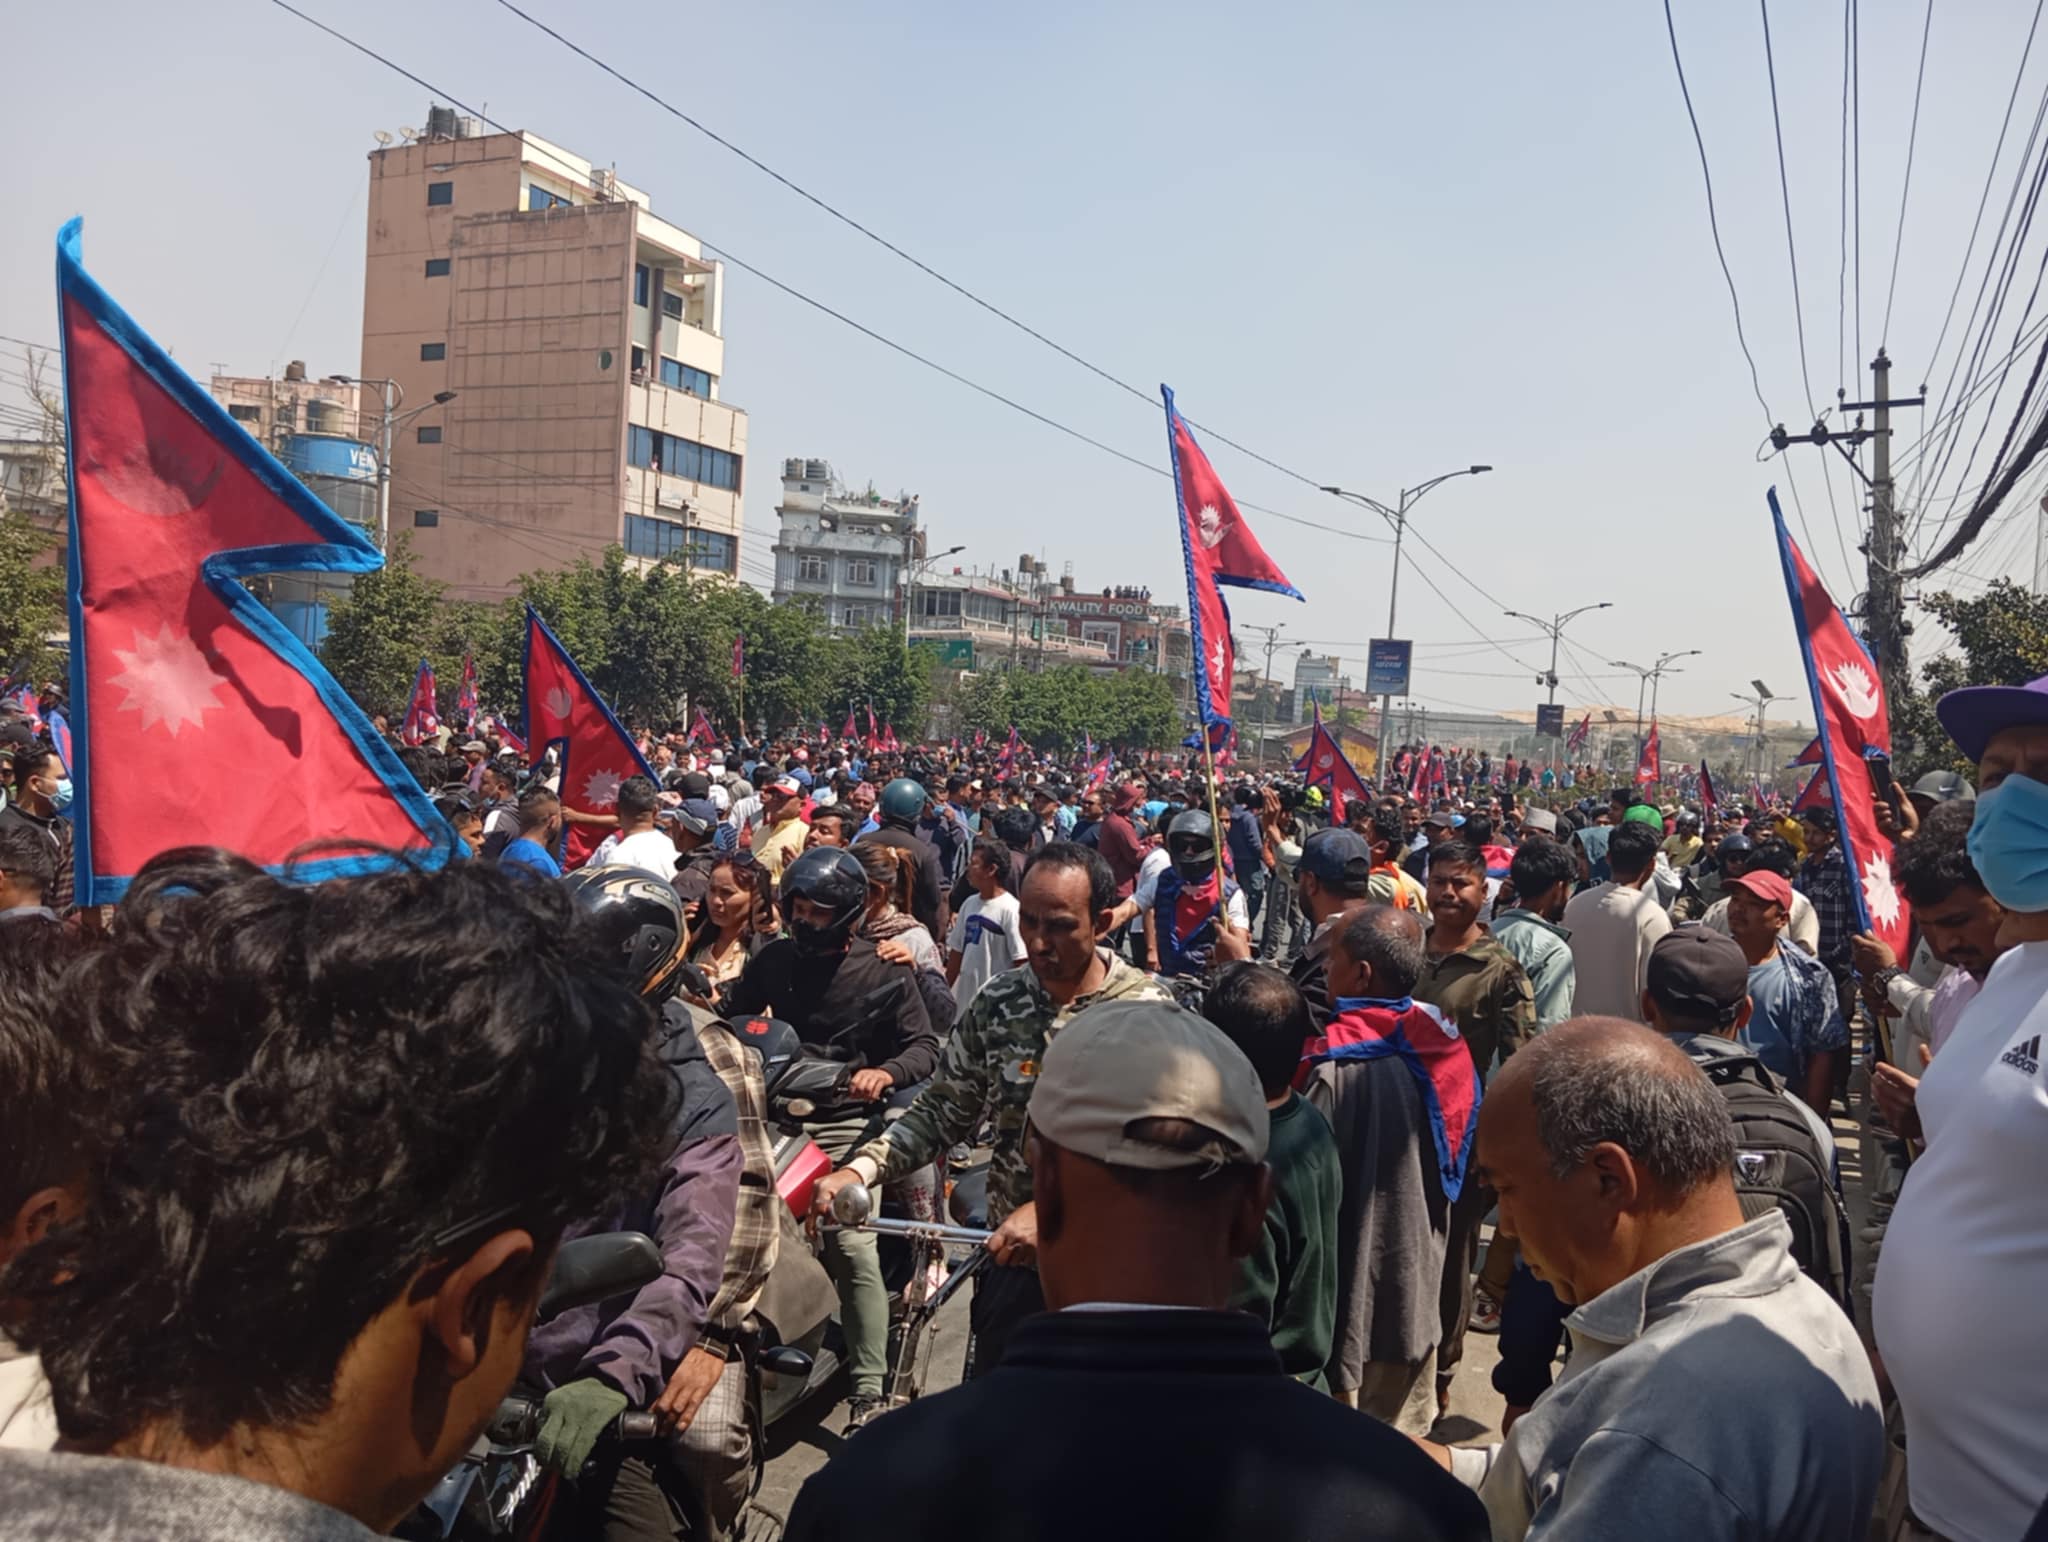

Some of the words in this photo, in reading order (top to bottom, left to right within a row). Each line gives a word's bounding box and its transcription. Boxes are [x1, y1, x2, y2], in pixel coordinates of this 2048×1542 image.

[1049, 600, 1103, 614] KWALITY
[1108, 603, 1143, 616] FOOD
[2001, 1051, 2039, 1075] adidas
